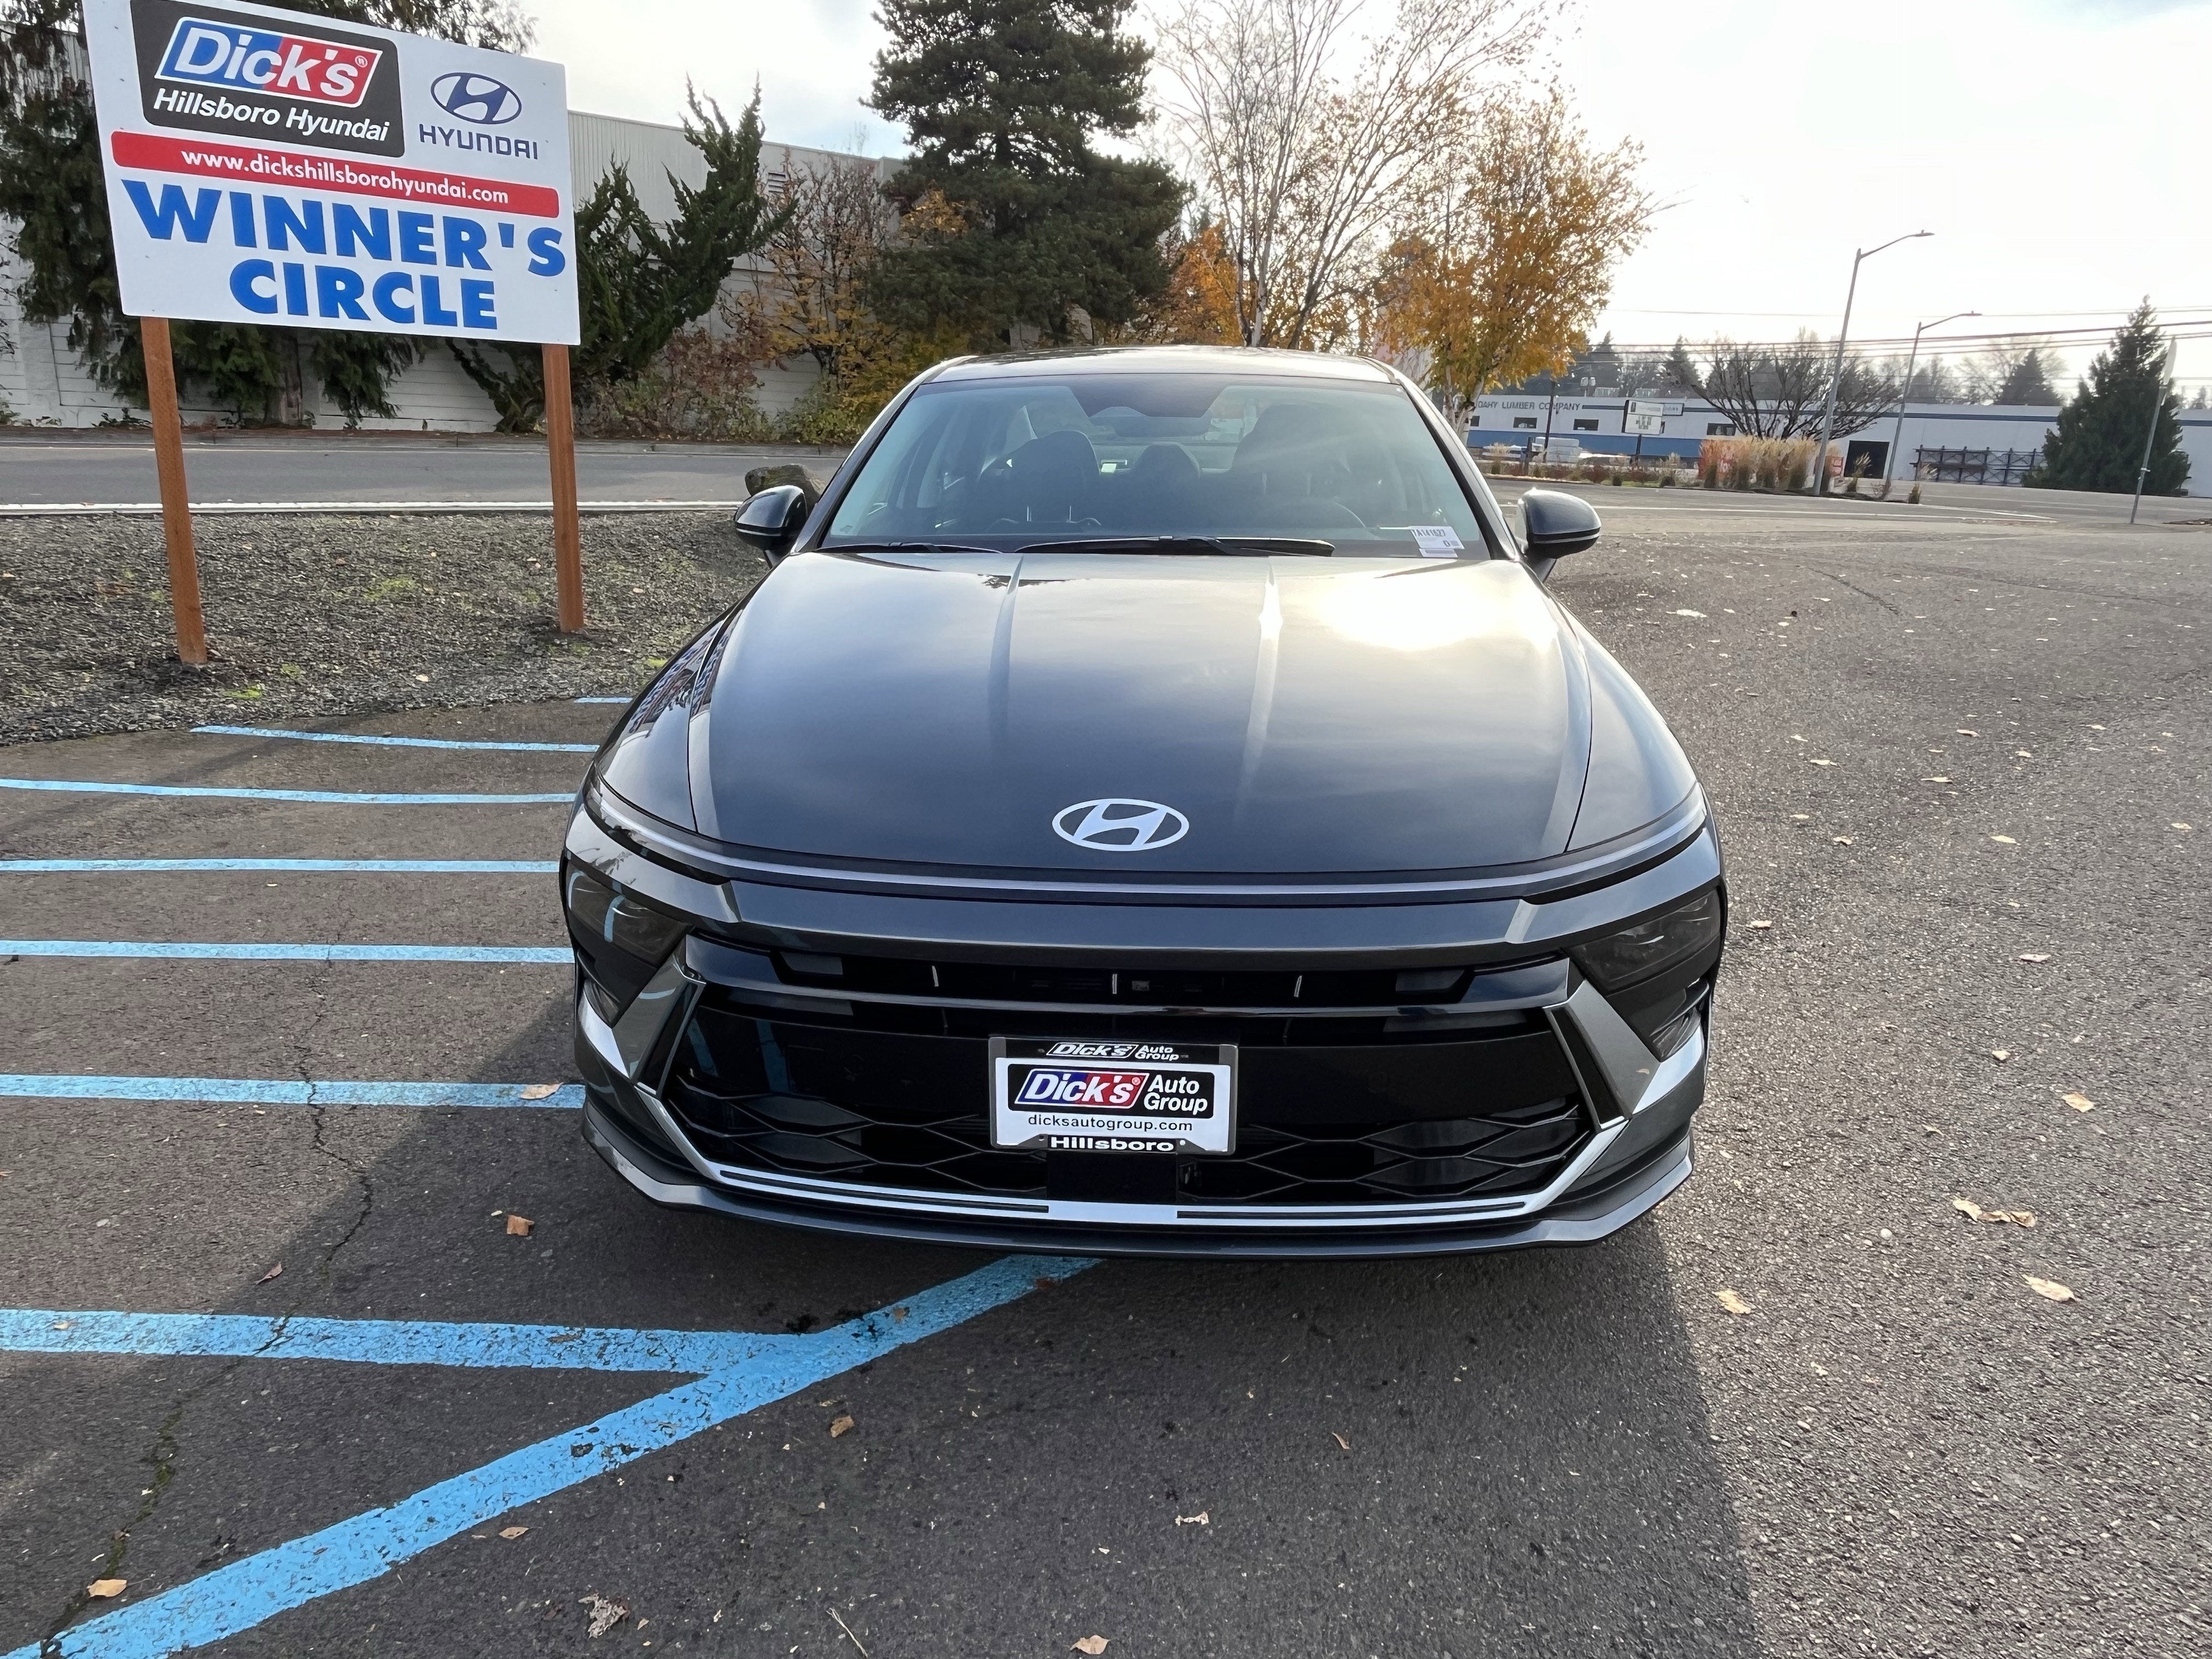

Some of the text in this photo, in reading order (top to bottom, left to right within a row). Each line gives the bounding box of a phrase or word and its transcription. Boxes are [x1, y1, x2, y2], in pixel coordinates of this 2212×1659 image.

[174, 27, 359, 98] Dick's
[154, 88, 391, 142] Hillsboro Hyundai
[420, 125, 538, 160] HYUNDAI
[182, 151, 509, 205] www.dickshillsborohyundai.com
[121, 179, 566, 277] WINNER'S
[229, 259, 498, 330] CIRCLE
[1051, 1043, 1132, 1057] Dick's
[1134, 1052, 1179, 1062] Group
[1137, 1045, 1173, 1053] Auto
[1024, 1073, 1135, 1104] Dick's
[1147, 1075, 1200, 1094] Auto
[1143, 1092, 1208, 1115] Group
[1028, 1114, 1193, 1131] dicksautogroup.com
[1050, 1137, 1174, 1152] Hillsboro
